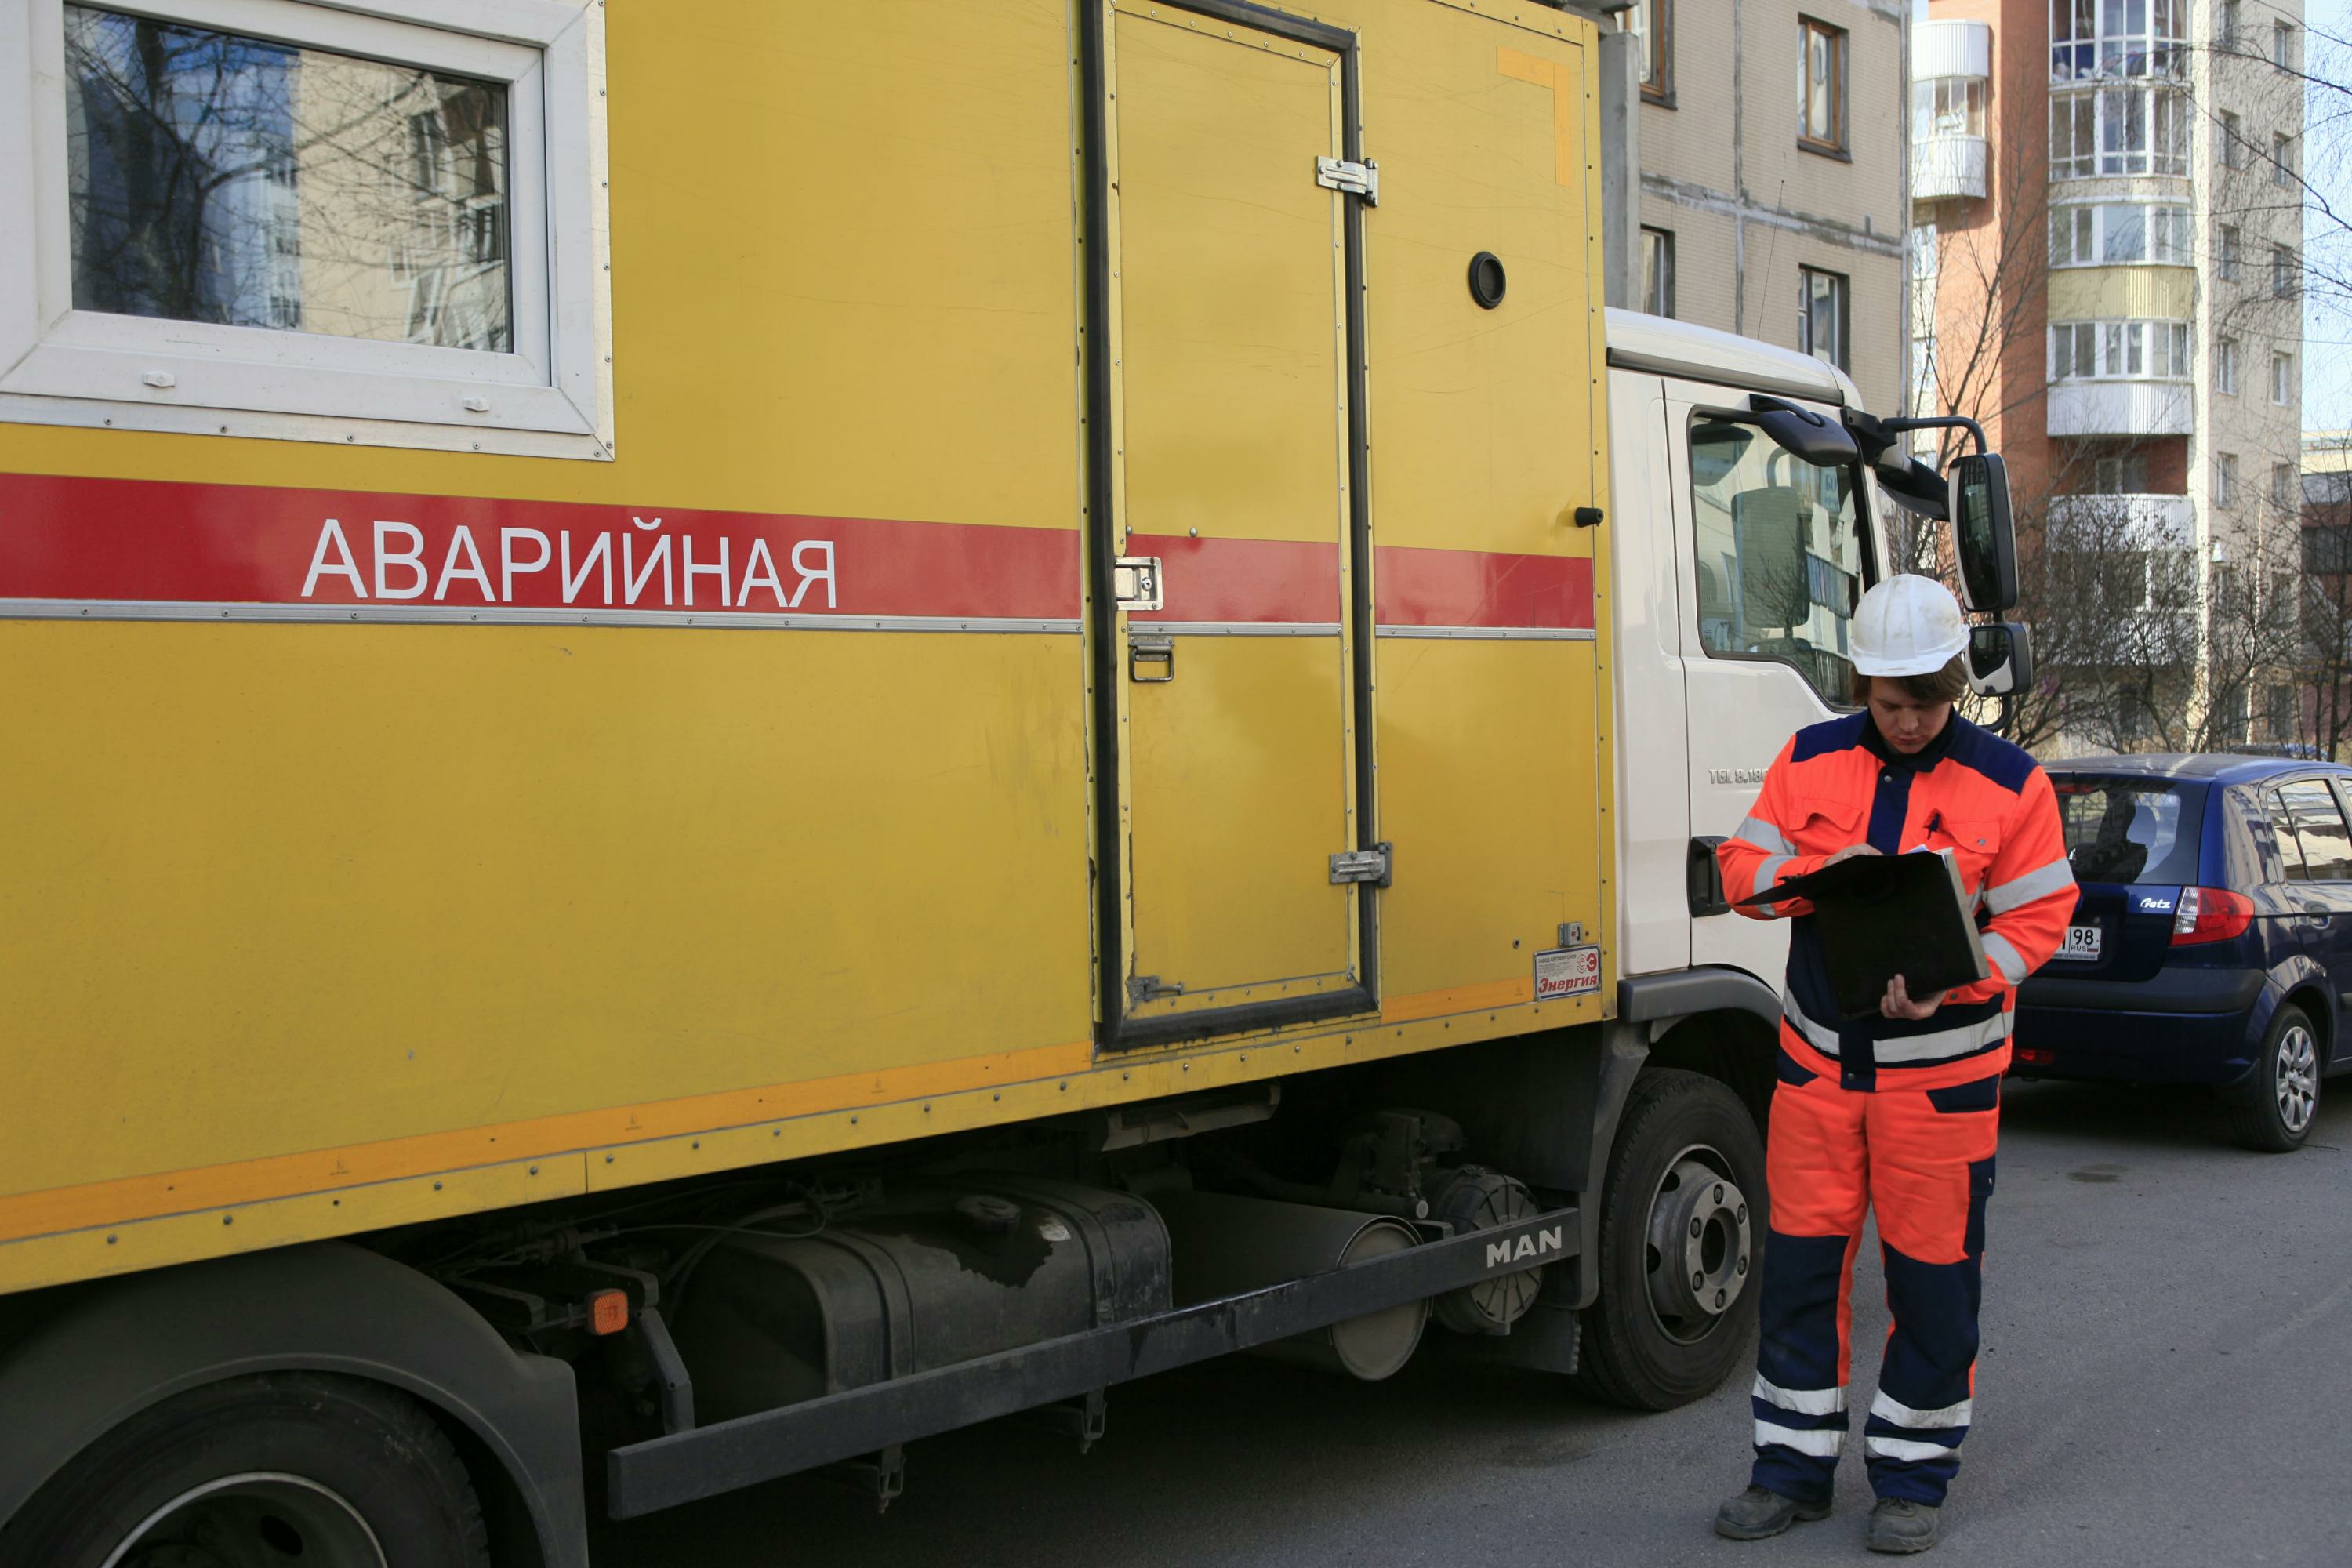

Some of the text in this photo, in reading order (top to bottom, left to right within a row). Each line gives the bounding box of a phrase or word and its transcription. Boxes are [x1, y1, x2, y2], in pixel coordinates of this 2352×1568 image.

[301, 517, 837, 608] АВАРИЙНАЯ
[1708, 768, 1733, 784] TGL
[2140, 897, 2171, 909] Getz
[2073, 928, 2094, 946] 98
[1538, 975, 1598, 993] Энергия
[1486, 1225, 1562, 1268] MAN
